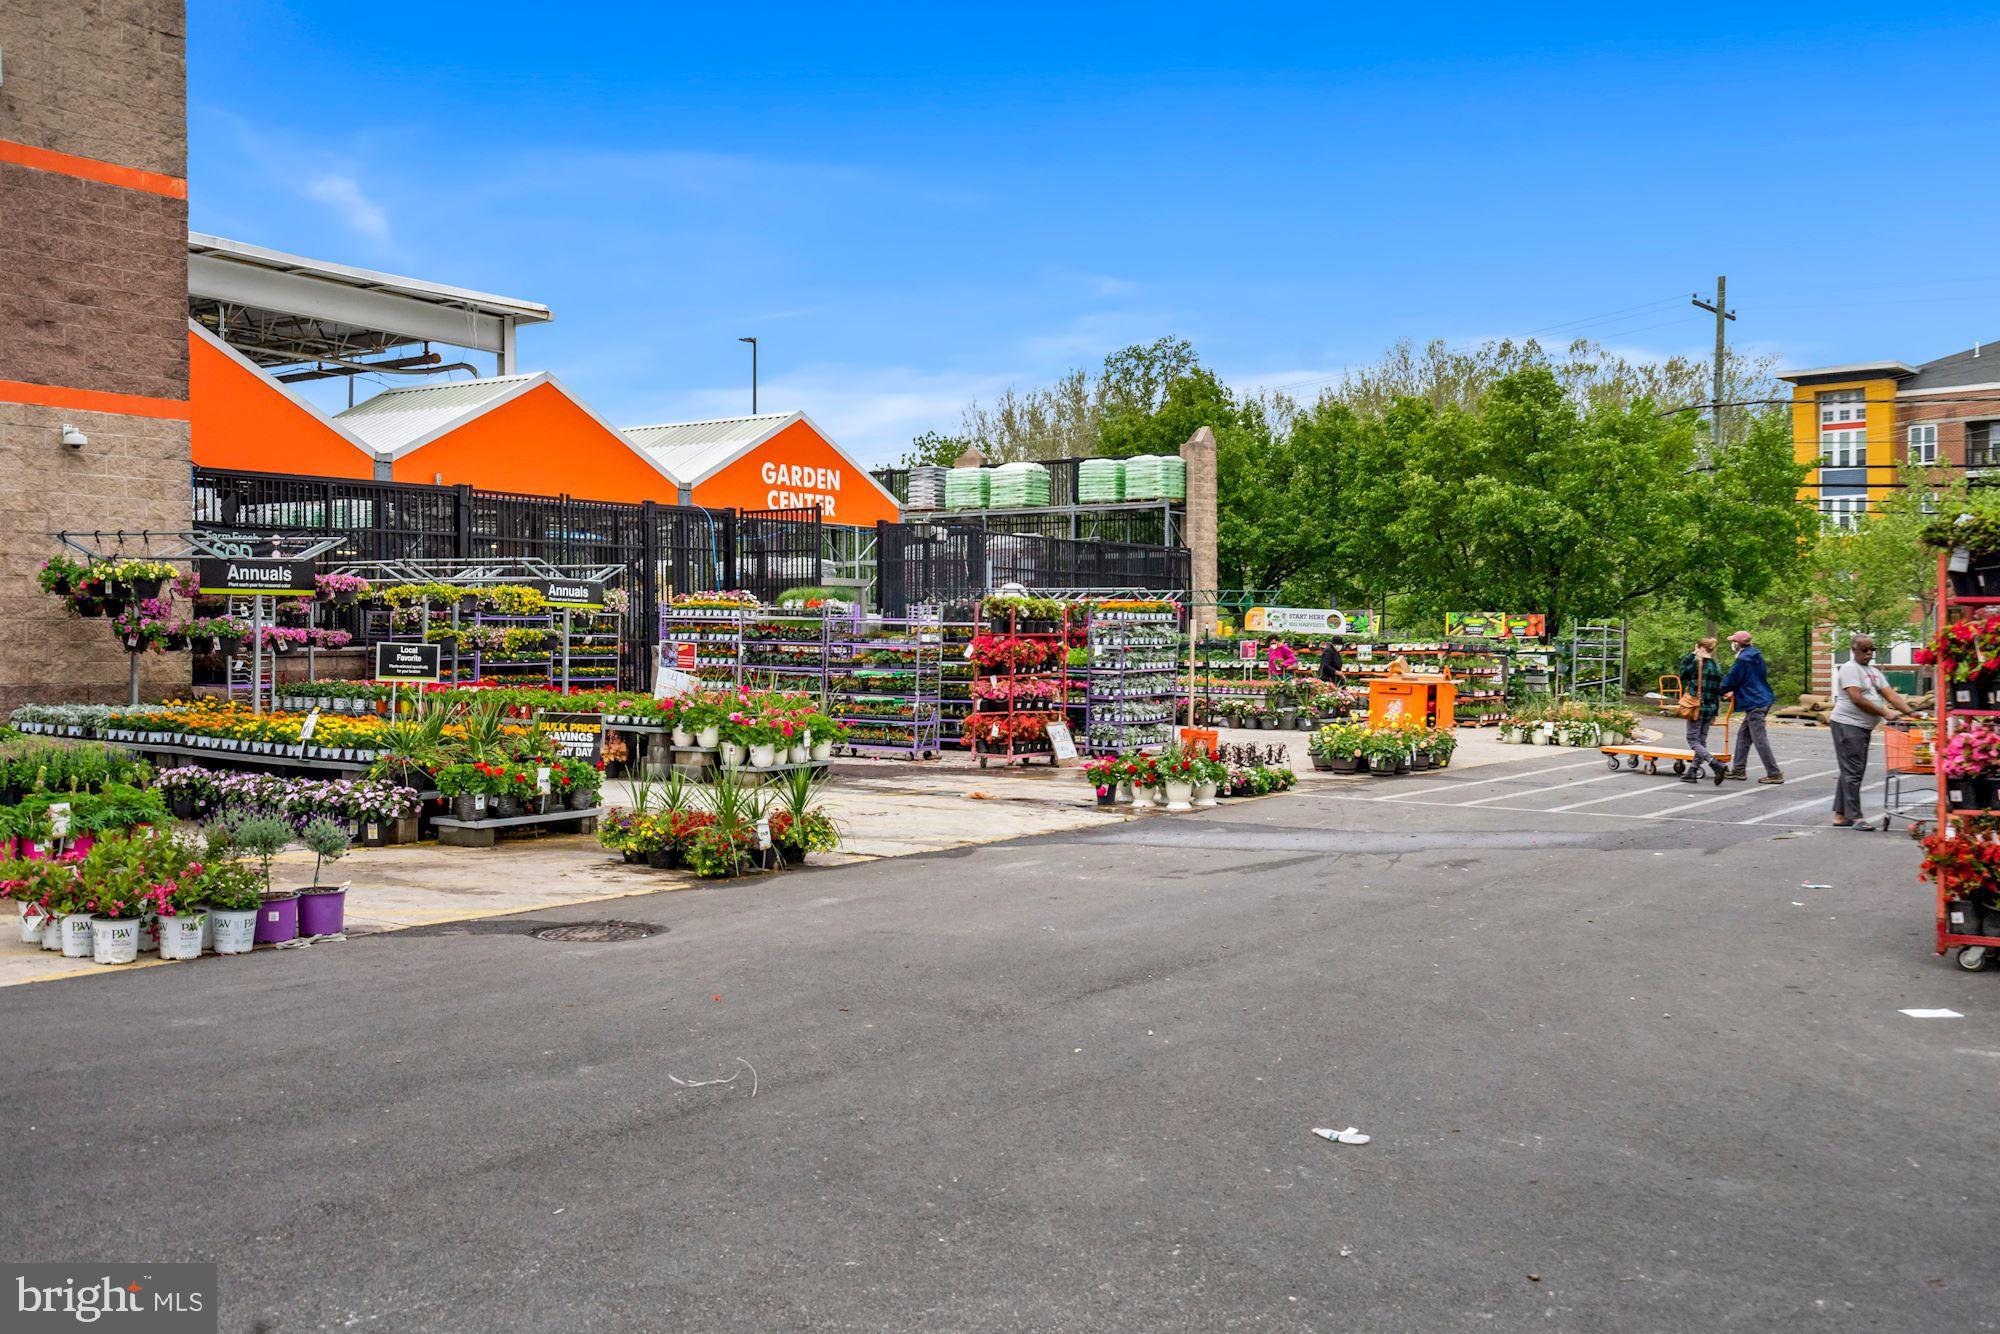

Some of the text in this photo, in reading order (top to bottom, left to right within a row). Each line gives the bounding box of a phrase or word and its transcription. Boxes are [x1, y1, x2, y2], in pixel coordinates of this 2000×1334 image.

[761, 462, 840, 491] GARDEN
[767, 489, 836, 516] CENTER
[227, 564, 292, 581] Annuals
[548, 584, 589, 598] Annuals
[400, 646, 418, 654] Local
[396, 654, 422, 662] Favorite
[569, 723, 601, 733] PRICE
[575, 747, 594, 757] DAY
